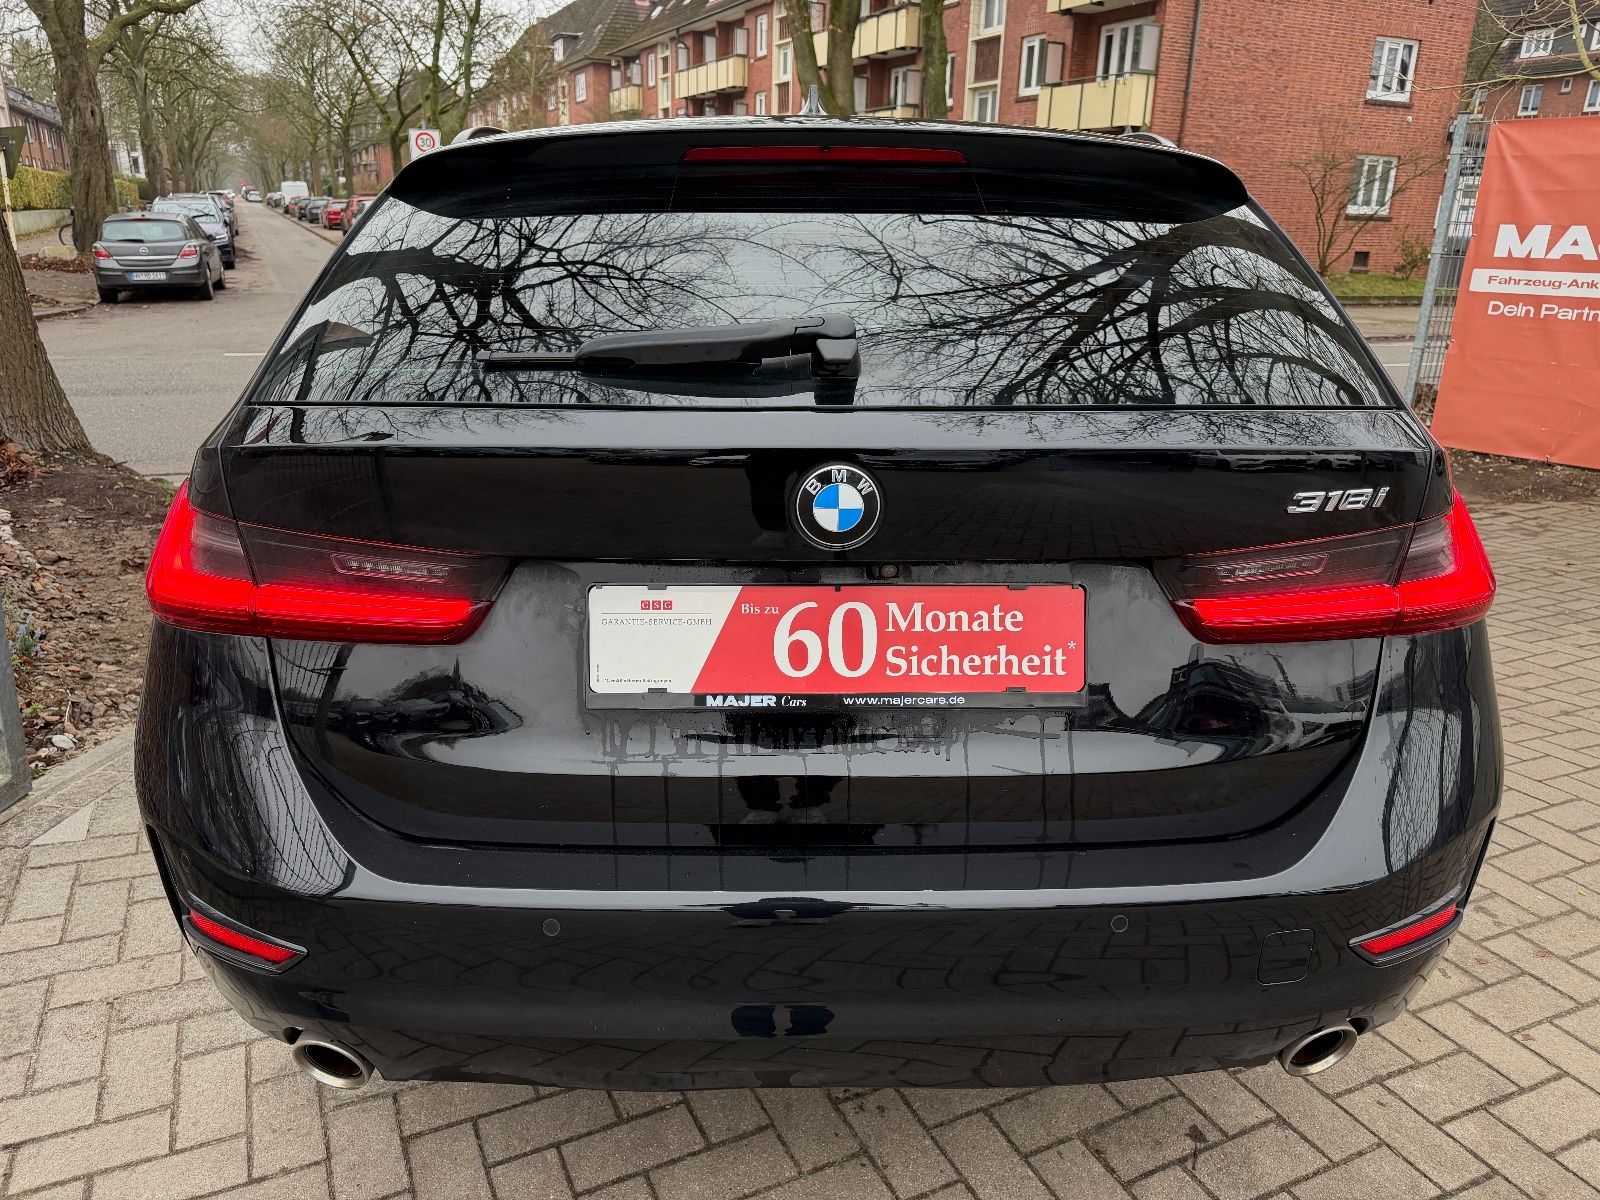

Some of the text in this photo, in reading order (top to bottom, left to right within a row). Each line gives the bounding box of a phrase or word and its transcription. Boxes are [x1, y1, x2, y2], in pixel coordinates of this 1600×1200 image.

[420, 137, 432, 147] 30
[1493, 224, 1600, 260] MA
[1487, 275, 1600, 290] Fahrzeug-Ank
[1487, 300, 1535, 318] Dein
[805, 469, 874, 496] BMW
[1286, 486, 1390, 514] 318i
[741, 603, 780, 615] Bis zu
[885, 602, 1024, 632] Monate
[773, 601, 878, 678] 60
[706, 695, 807, 707] MAJER Cars
[843, 695, 966, 707] www.majercars.de
